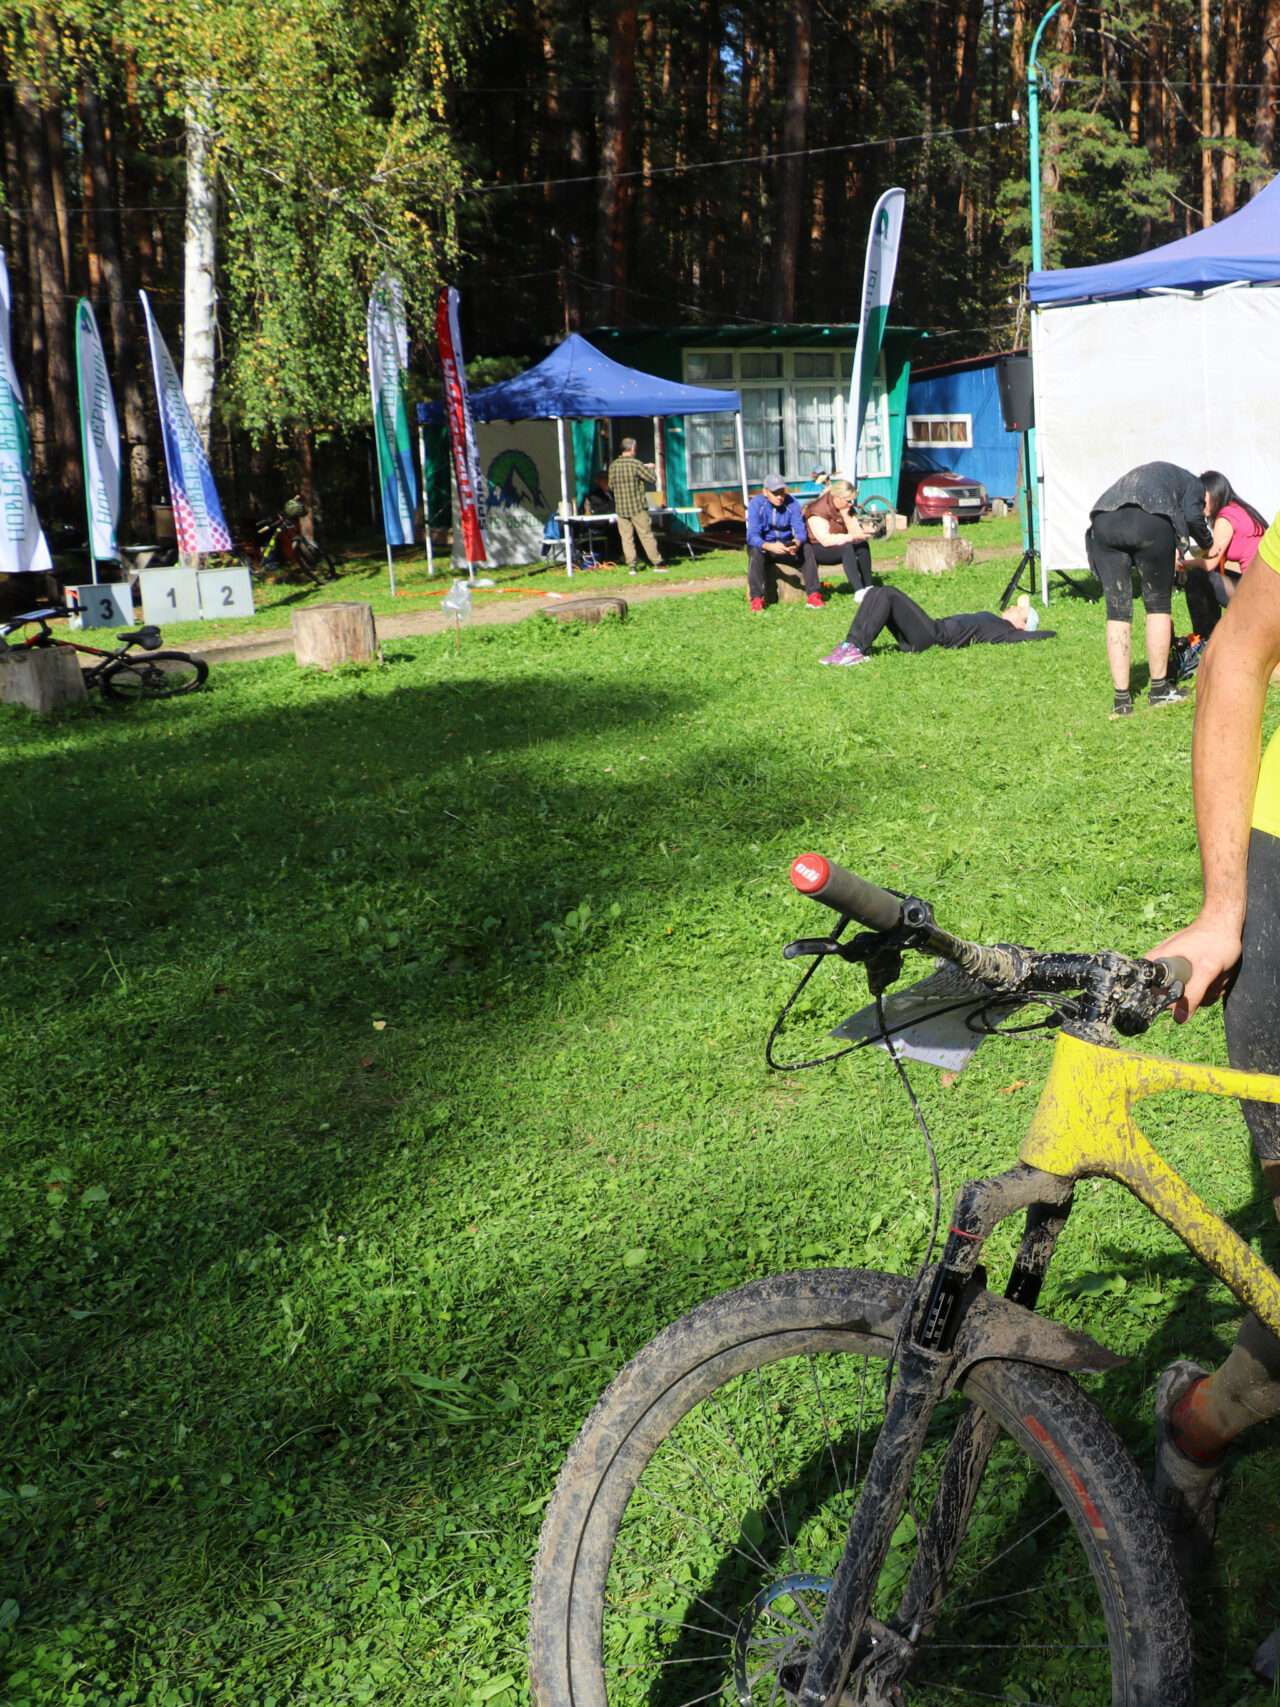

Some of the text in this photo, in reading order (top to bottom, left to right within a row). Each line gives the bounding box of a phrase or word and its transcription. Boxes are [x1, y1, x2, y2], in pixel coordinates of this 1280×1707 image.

[166, 587, 177, 608] 1
[220, 585, 235, 606] 2
[100, 598, 114, 620] 3
